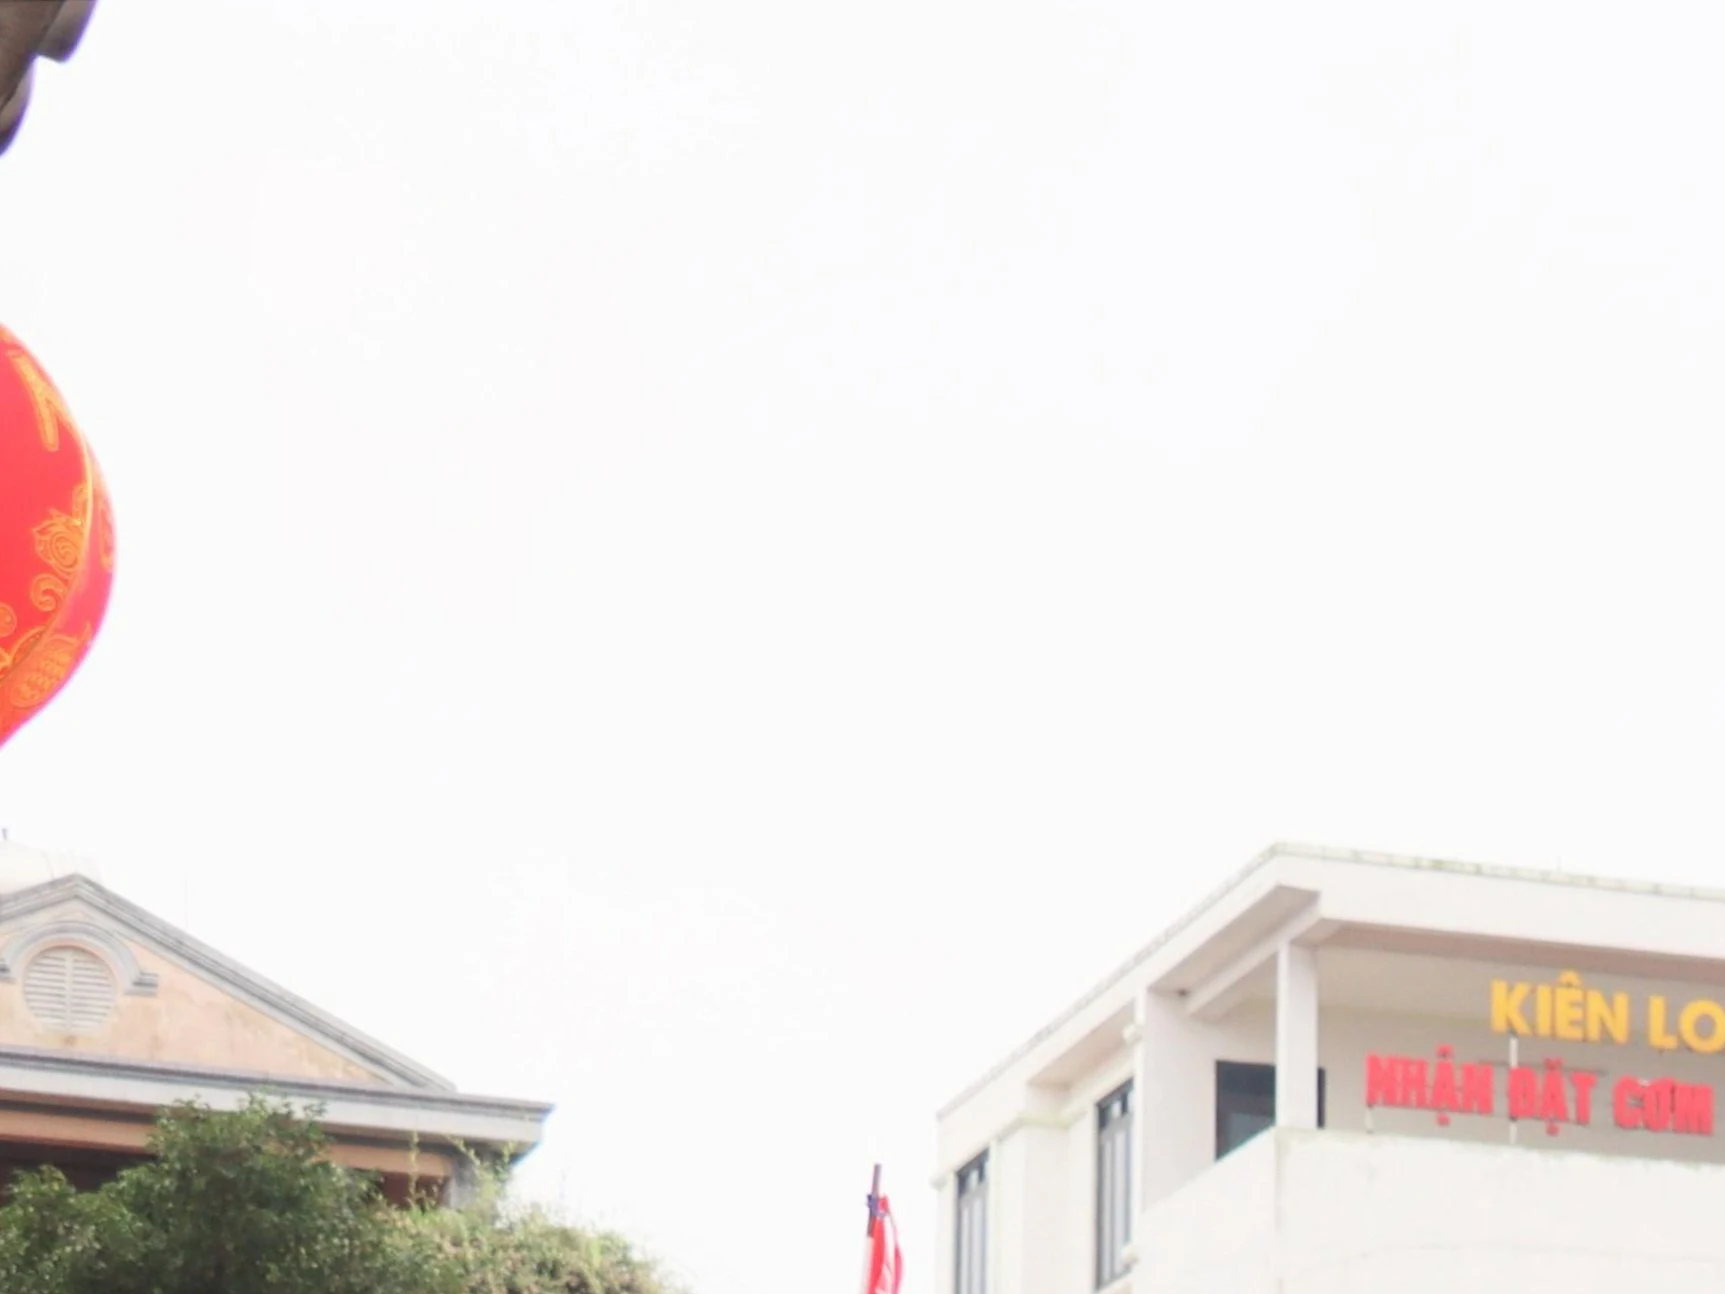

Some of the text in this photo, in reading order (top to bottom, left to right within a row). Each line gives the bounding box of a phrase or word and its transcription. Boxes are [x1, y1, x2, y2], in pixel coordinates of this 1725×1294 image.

[1489, 970, 1630, 1044] KIÊN
[1365, 1045, 1494, 1127] NHẬN
[1508, 1058, 1597, 1136] ĐẶT
